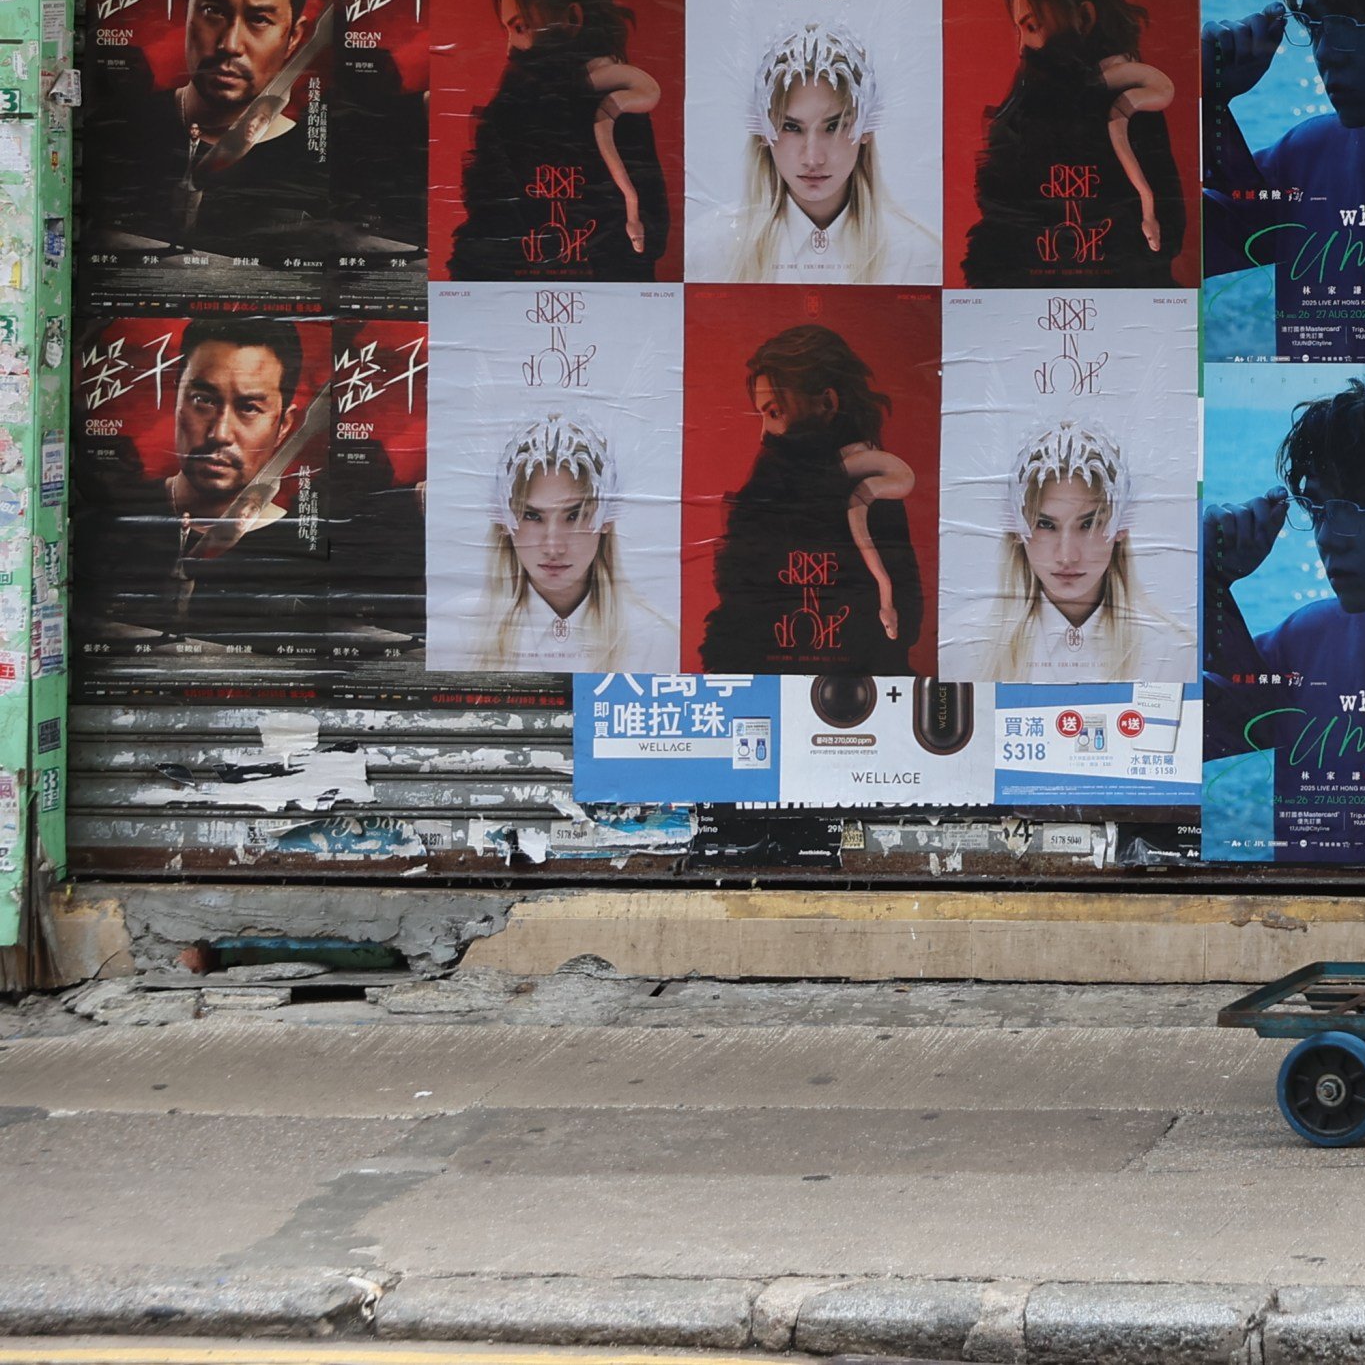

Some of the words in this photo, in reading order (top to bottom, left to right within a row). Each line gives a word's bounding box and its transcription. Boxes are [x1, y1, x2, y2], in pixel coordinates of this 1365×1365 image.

[96, 29, 133, 39] ORGAN
[96, 37, 129, 47] CHILD
[526, 163, 585, 200] RISE
[550, 200, 567, 226] IN
[1037, 296, 1098, 332] RISE
[1062, 332, 1079, 359] IN
[1004, 716, 1046, 737] 買滿
[638, 741, 693, 752] WELLAGE
[1002, 741, 1047, 762] $318
[851, 771, 922, 785] WELLAGE
